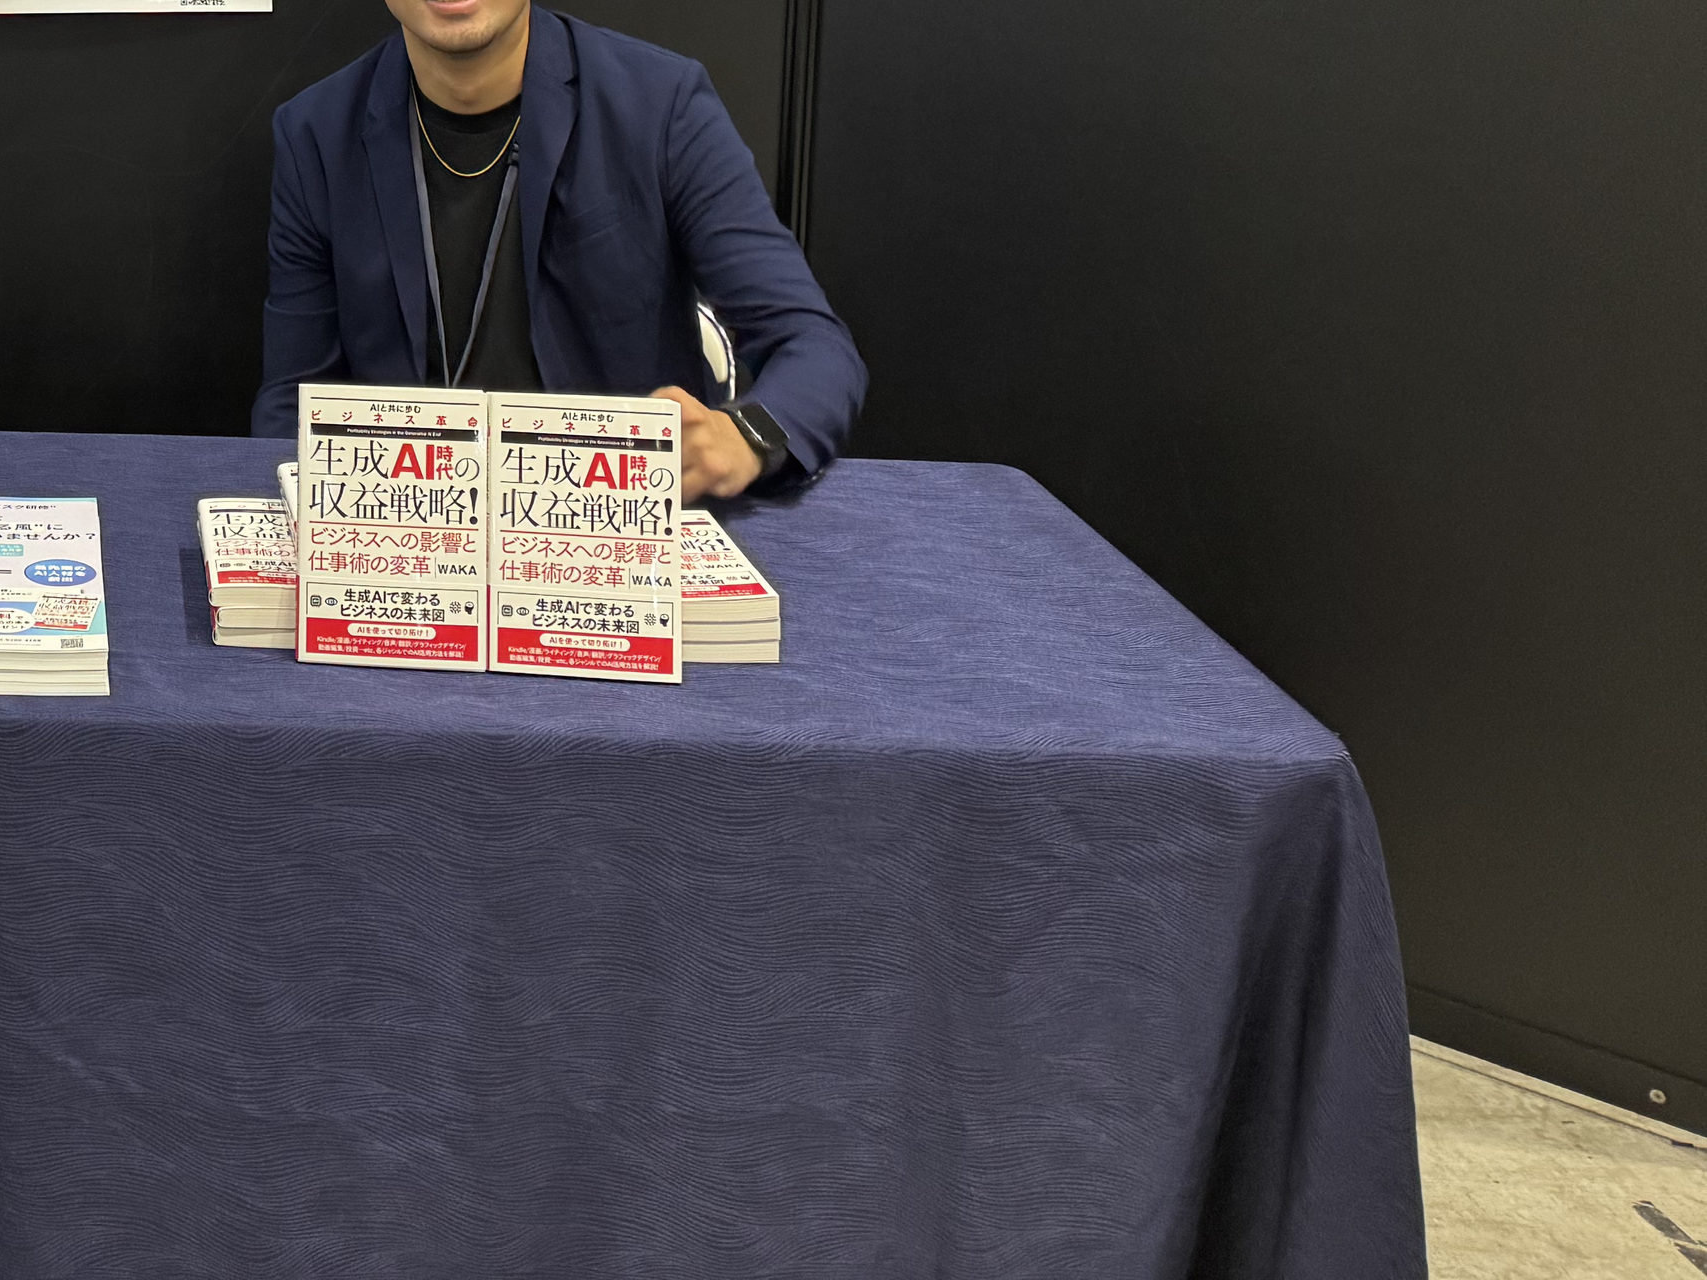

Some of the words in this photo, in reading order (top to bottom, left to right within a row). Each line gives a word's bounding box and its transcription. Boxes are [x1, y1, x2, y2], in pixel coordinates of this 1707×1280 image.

[369, 404, 422, 414] AIと共に歩む
[561, 412, 615, 423] AIと共に歩む
[309, 438, 480, 482] 生成AI時代の
[499, 446, 675, 493] 生成AI時代の
[309, 480, 479, 526] 収益戦略!
[499, 488, 674, 537] 収益戦略!
[310, 528, 476, 554] ビジネスへの影響と
[501, 536, 671, 566] ビジネスへの影響と
[309, 550, 432, 577] 仕事術の変革
[437, 564, 476, 576] WAKA
[500, 559, 626, 588] 仕事術の変革
[632, 575, 671, 587] WAKA
[343, 589, 440, 606] 生成AIで変わる
[535, 598, 635, 618] 生成AIで変わる
[340, 604, 445, 623] ビジネスの未来図
[532, 614, 640, 634] ビジネスの未来図
